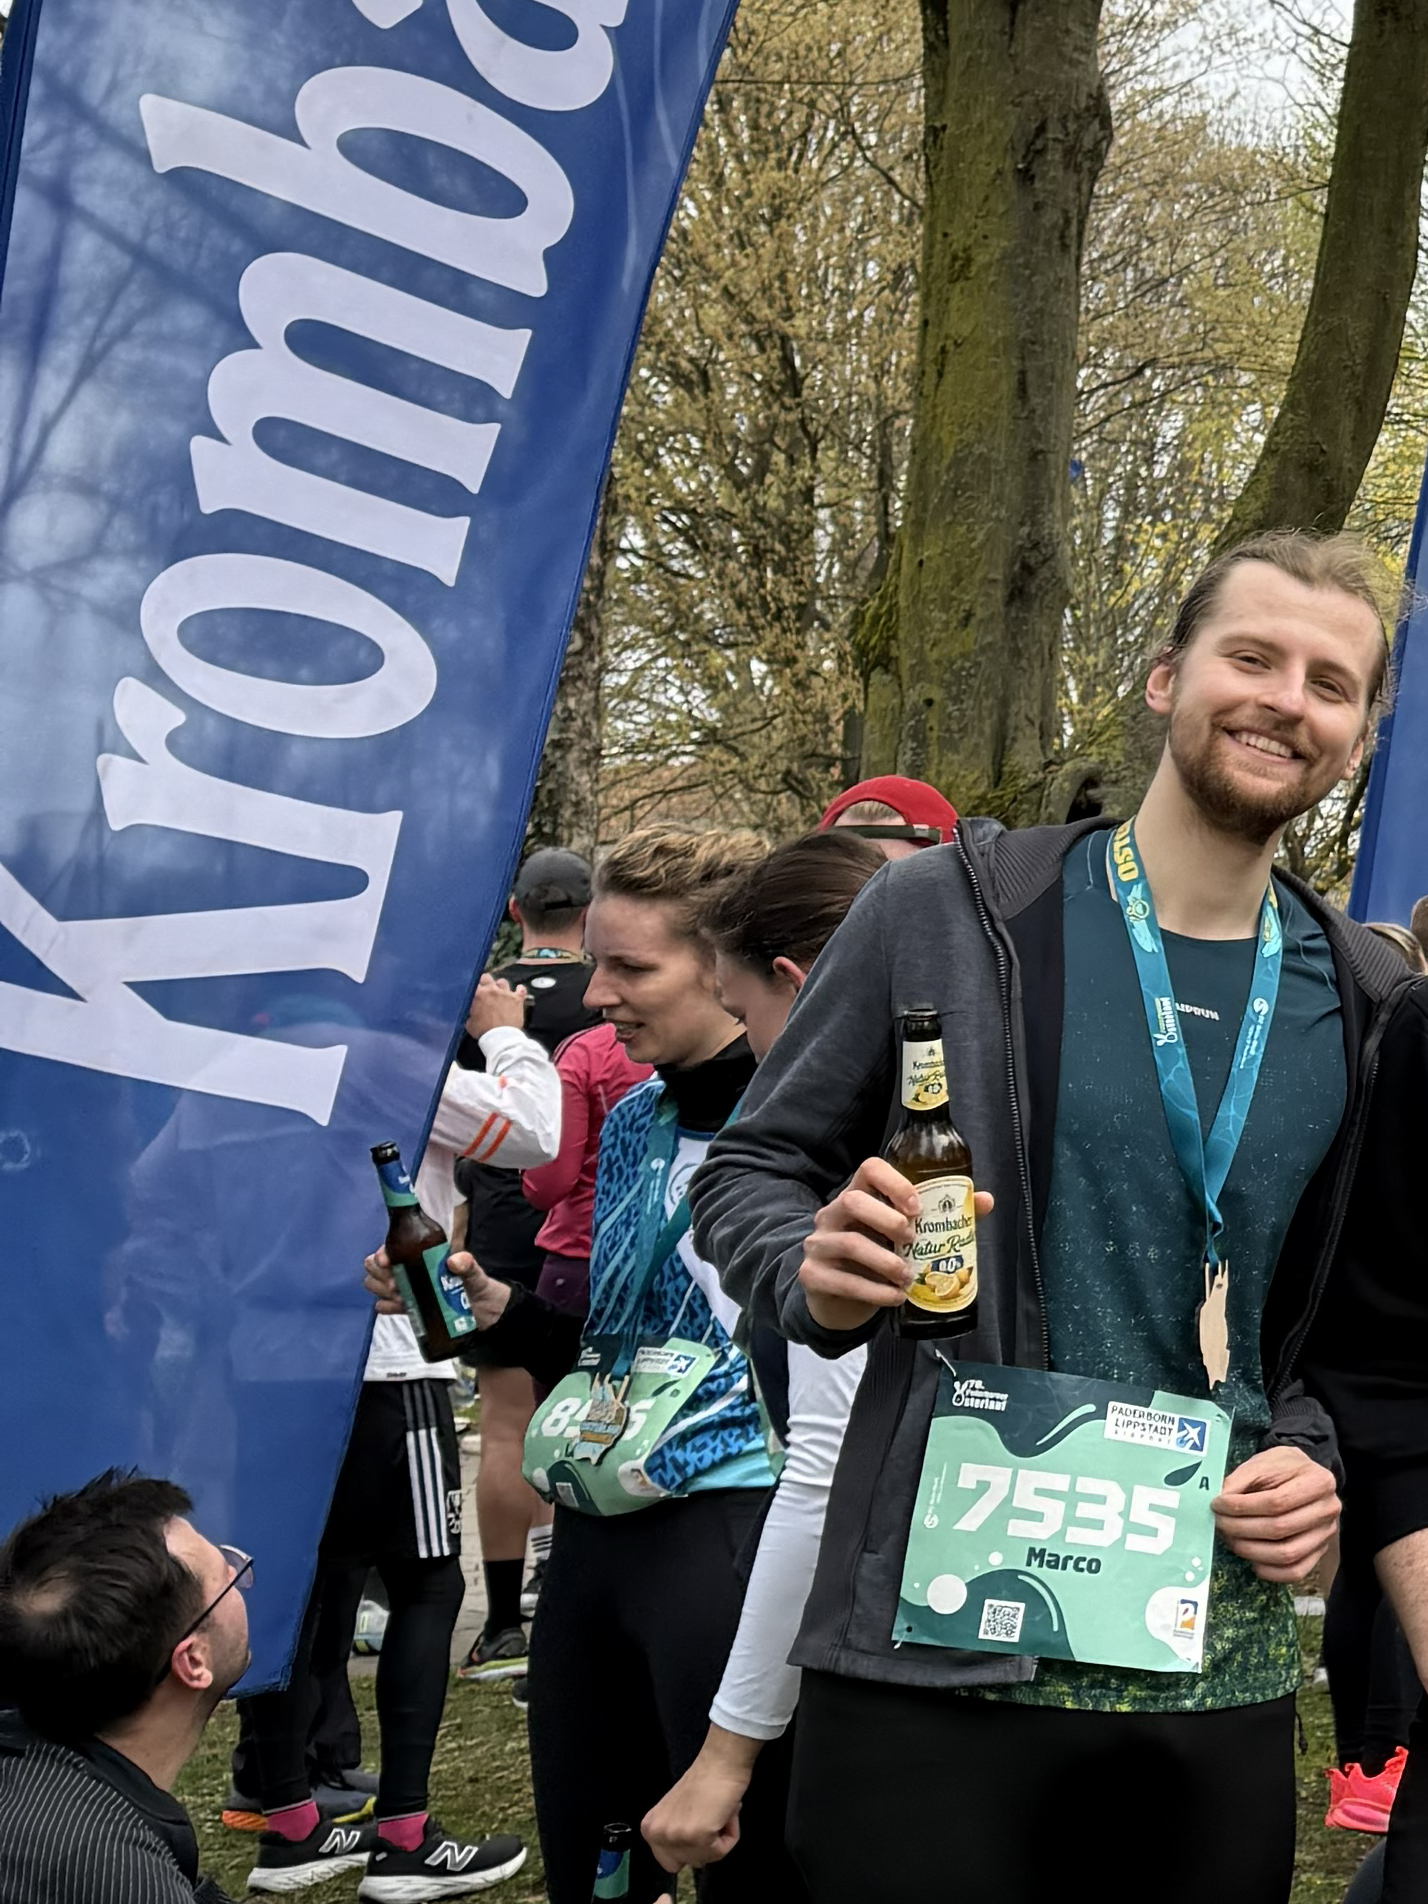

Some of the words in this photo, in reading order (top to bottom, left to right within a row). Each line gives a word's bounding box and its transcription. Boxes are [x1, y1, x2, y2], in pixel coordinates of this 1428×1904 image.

[1114, 1418, 1174, 1437] LIPPSTADT
[1199, 1476, 1210, 1491] A
[952, 1462, 1182, 1556] 7535
[1025, 1546, 1102, 1575] Marco
